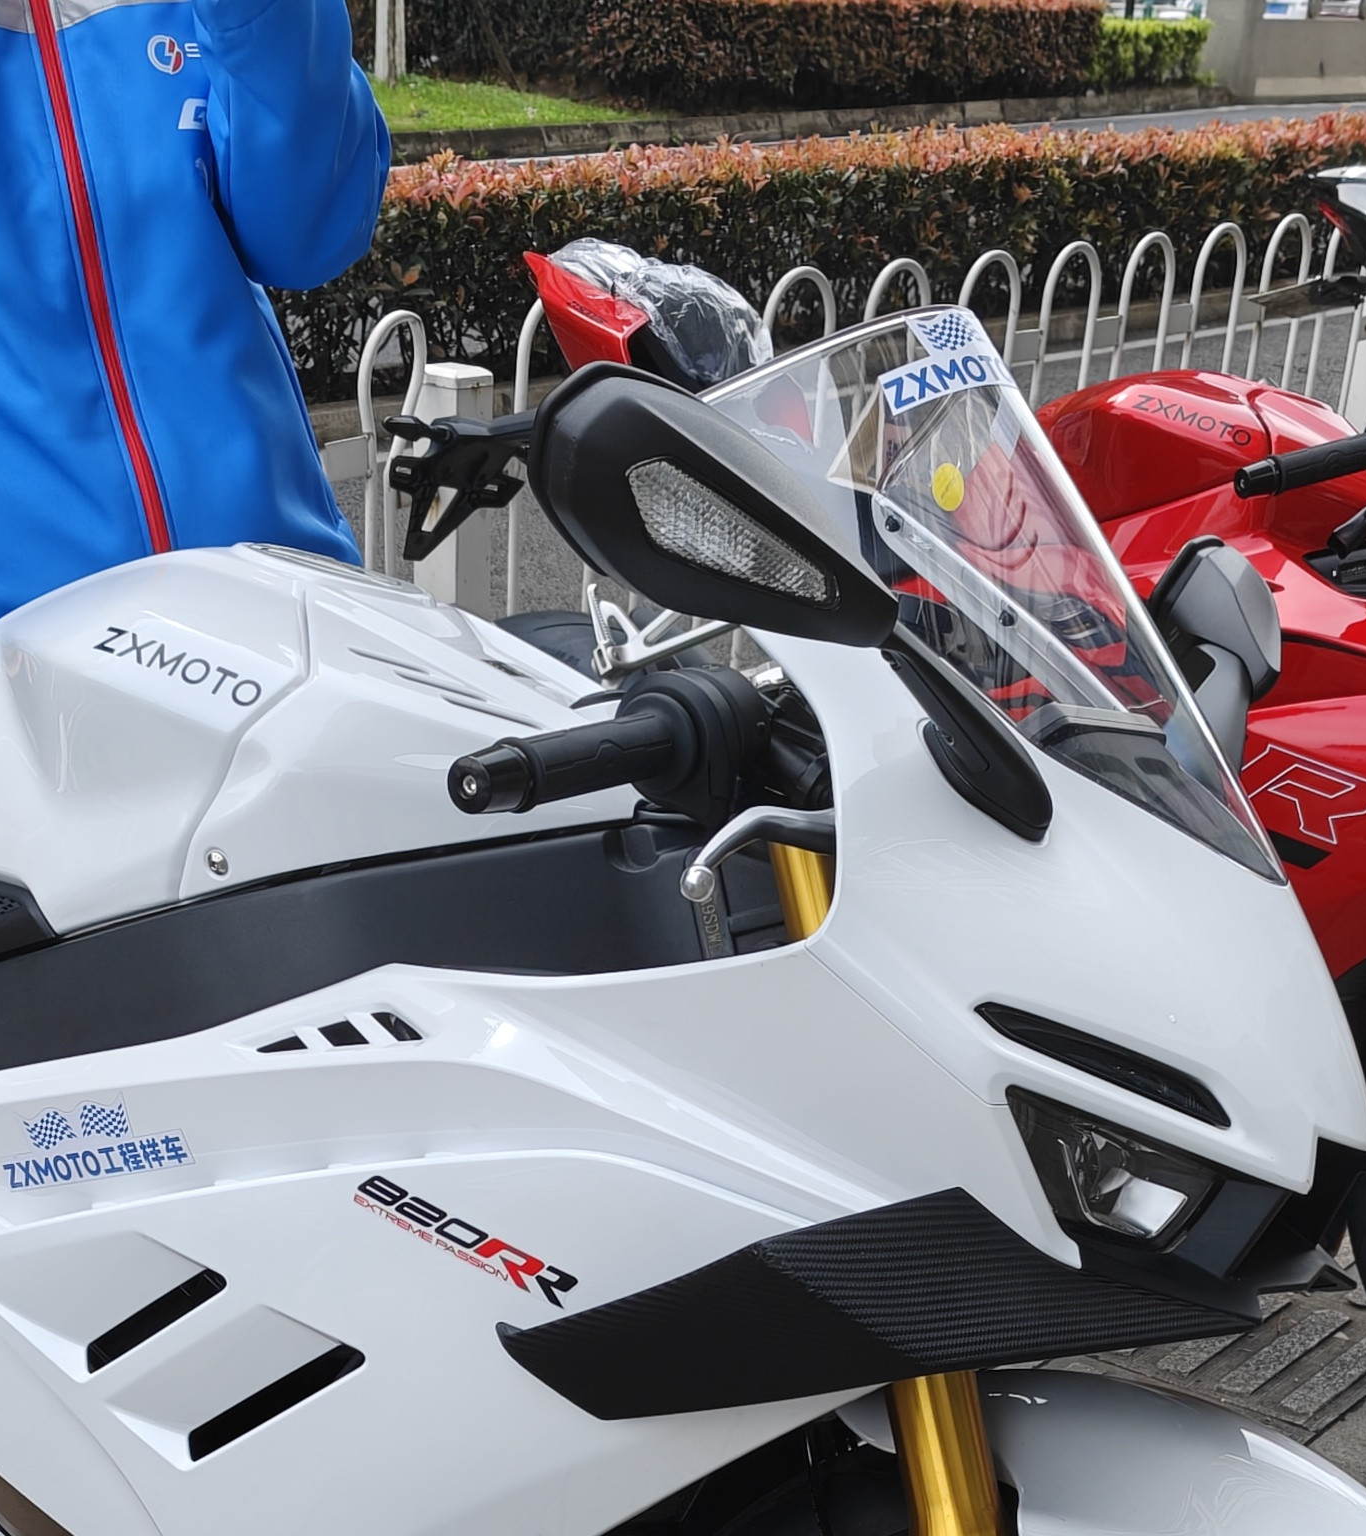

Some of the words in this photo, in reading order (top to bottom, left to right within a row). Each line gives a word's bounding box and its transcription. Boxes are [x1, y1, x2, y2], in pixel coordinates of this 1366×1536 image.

[1132, 394, 1252, 446] ZXMOTO
[92, 626, 262, 707] ZXMOTO
[353, 1192, 434, 1244] EXTREME
[357, 1175, 579, 1309] 820RR
[434, 1236, 509, 1282] PASSION
